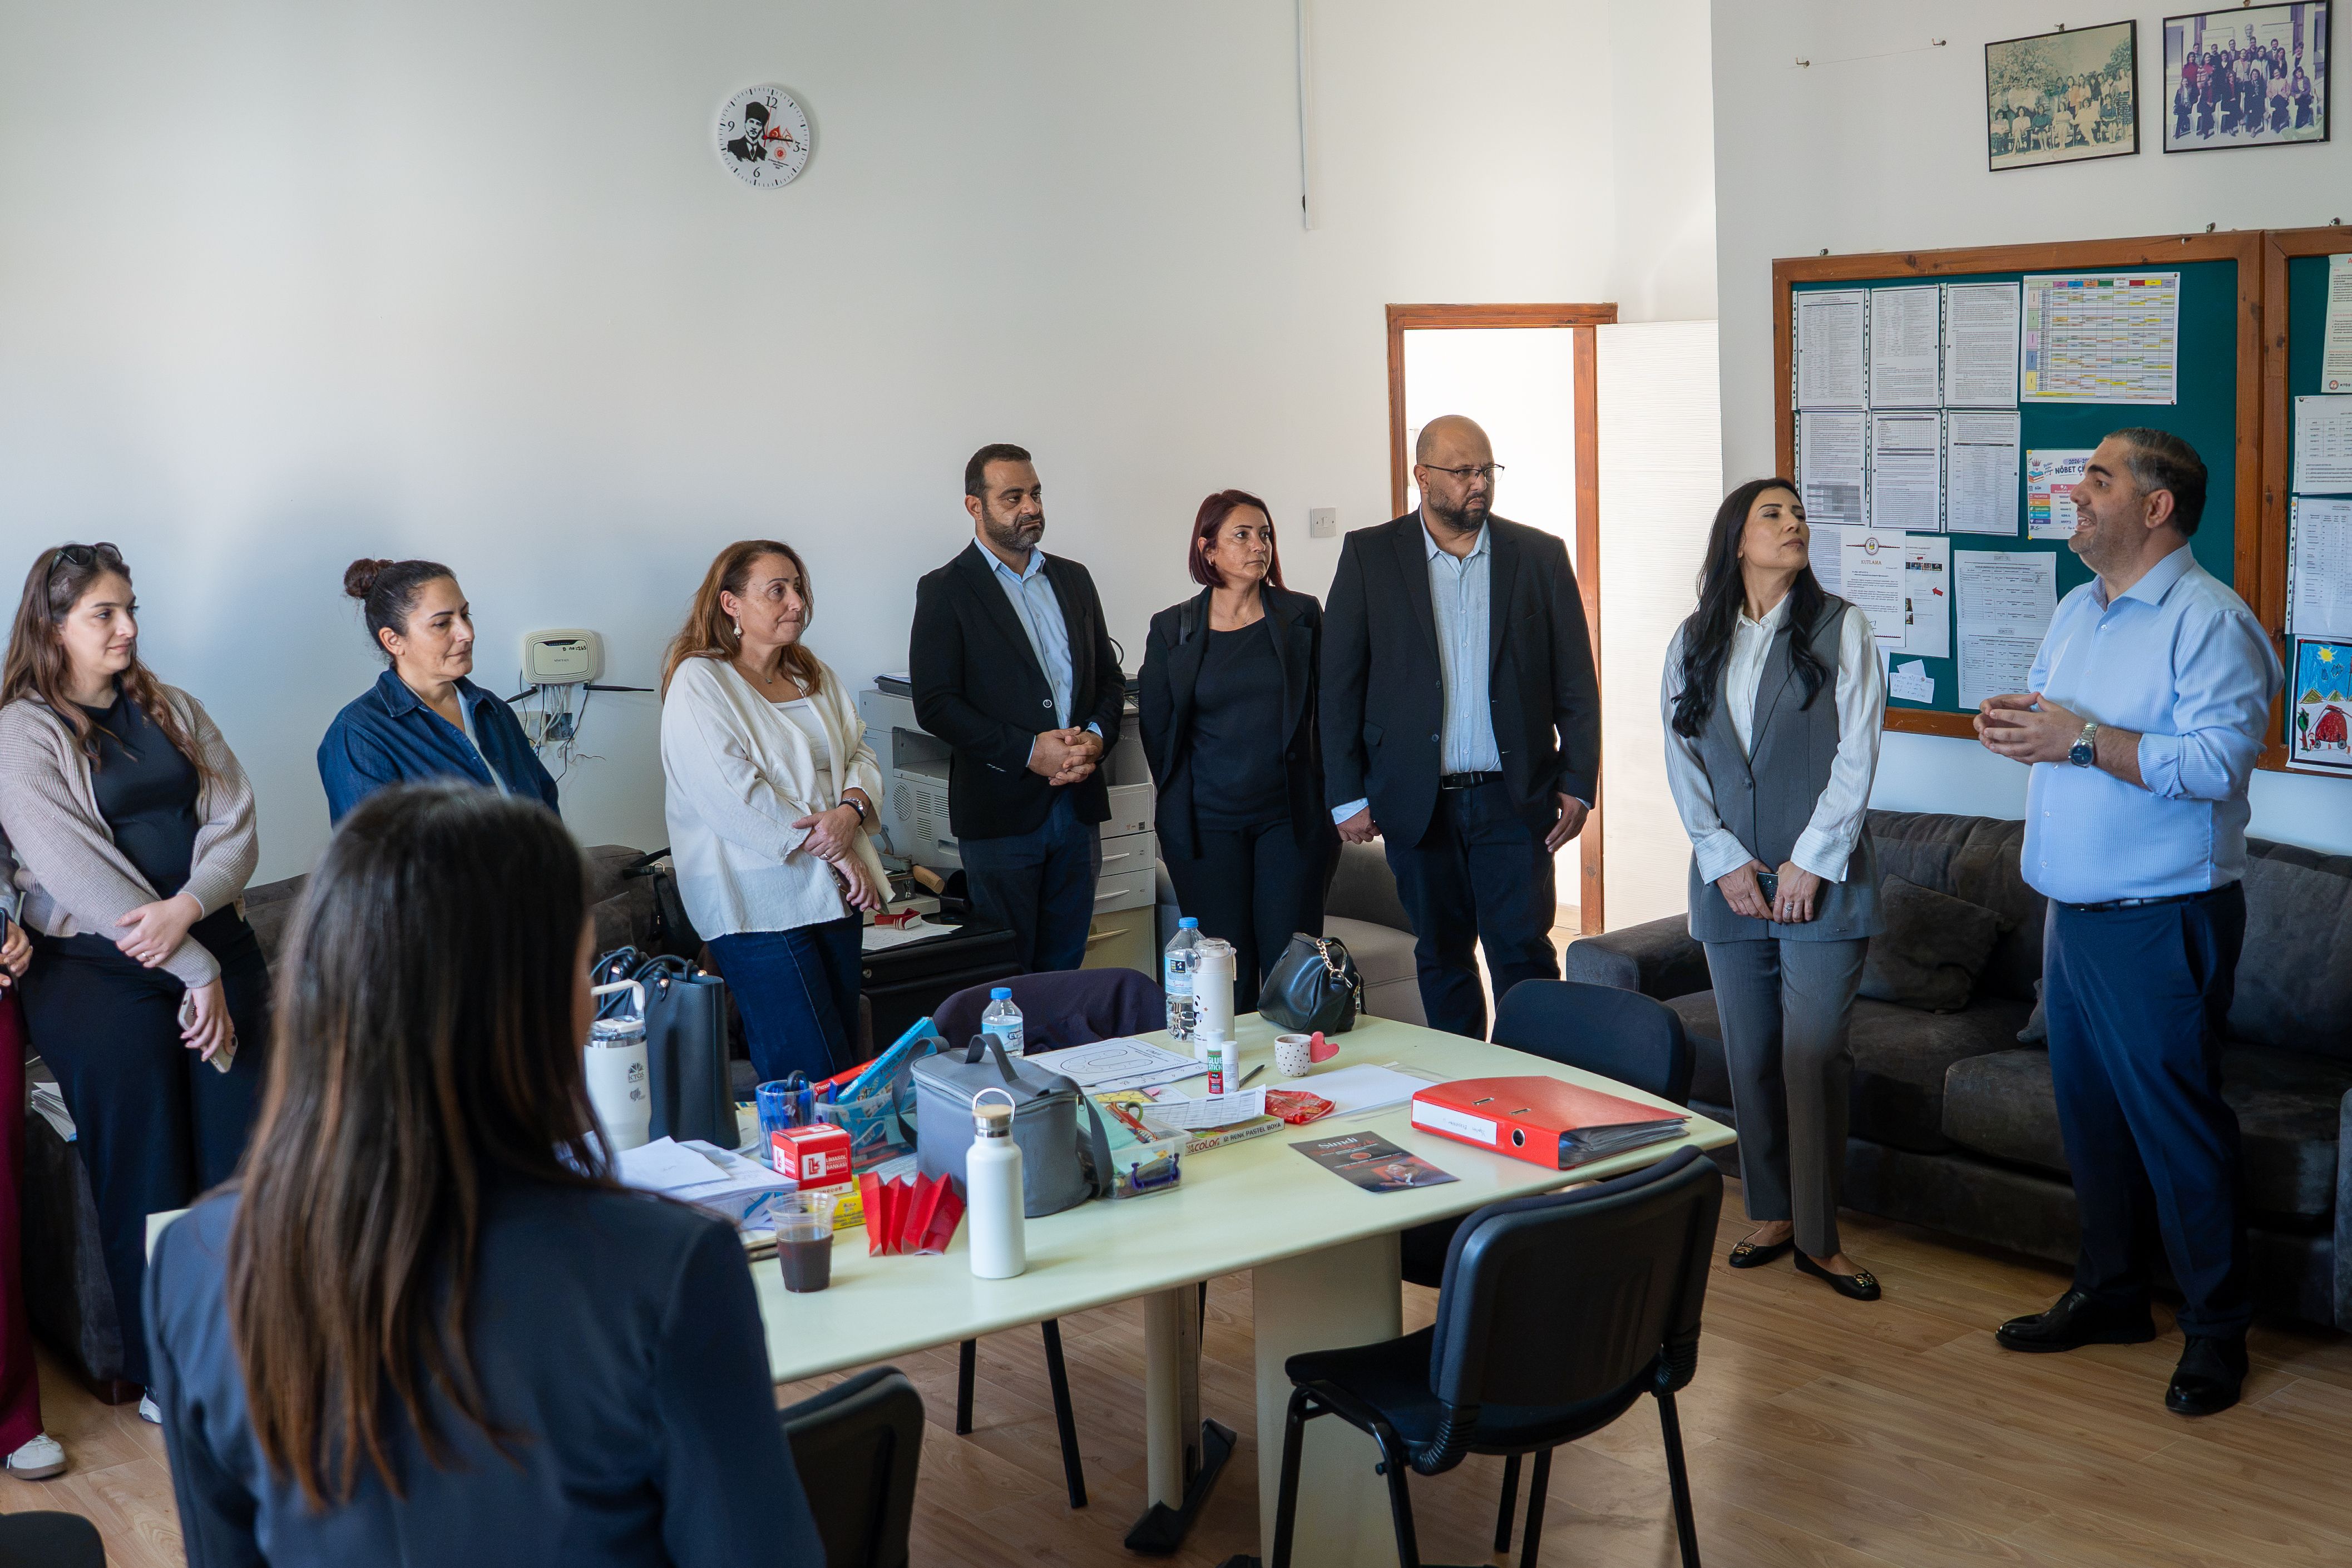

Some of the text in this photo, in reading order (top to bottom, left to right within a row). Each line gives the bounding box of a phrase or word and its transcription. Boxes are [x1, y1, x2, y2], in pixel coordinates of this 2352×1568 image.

[765, 96, 778, 110] 12
[728, 121, 735, 132] 9
[793, 141, 801, 152] 3
[753, 166, 761, 178] 6
[2055, 465, 2076, 474] NÖBET
[1230, 1132, 1245, 1141] RENK
[1246, 1127, 1266, 1137] PASTEL
[1267, 1122, 1281, 1130] BOYA
